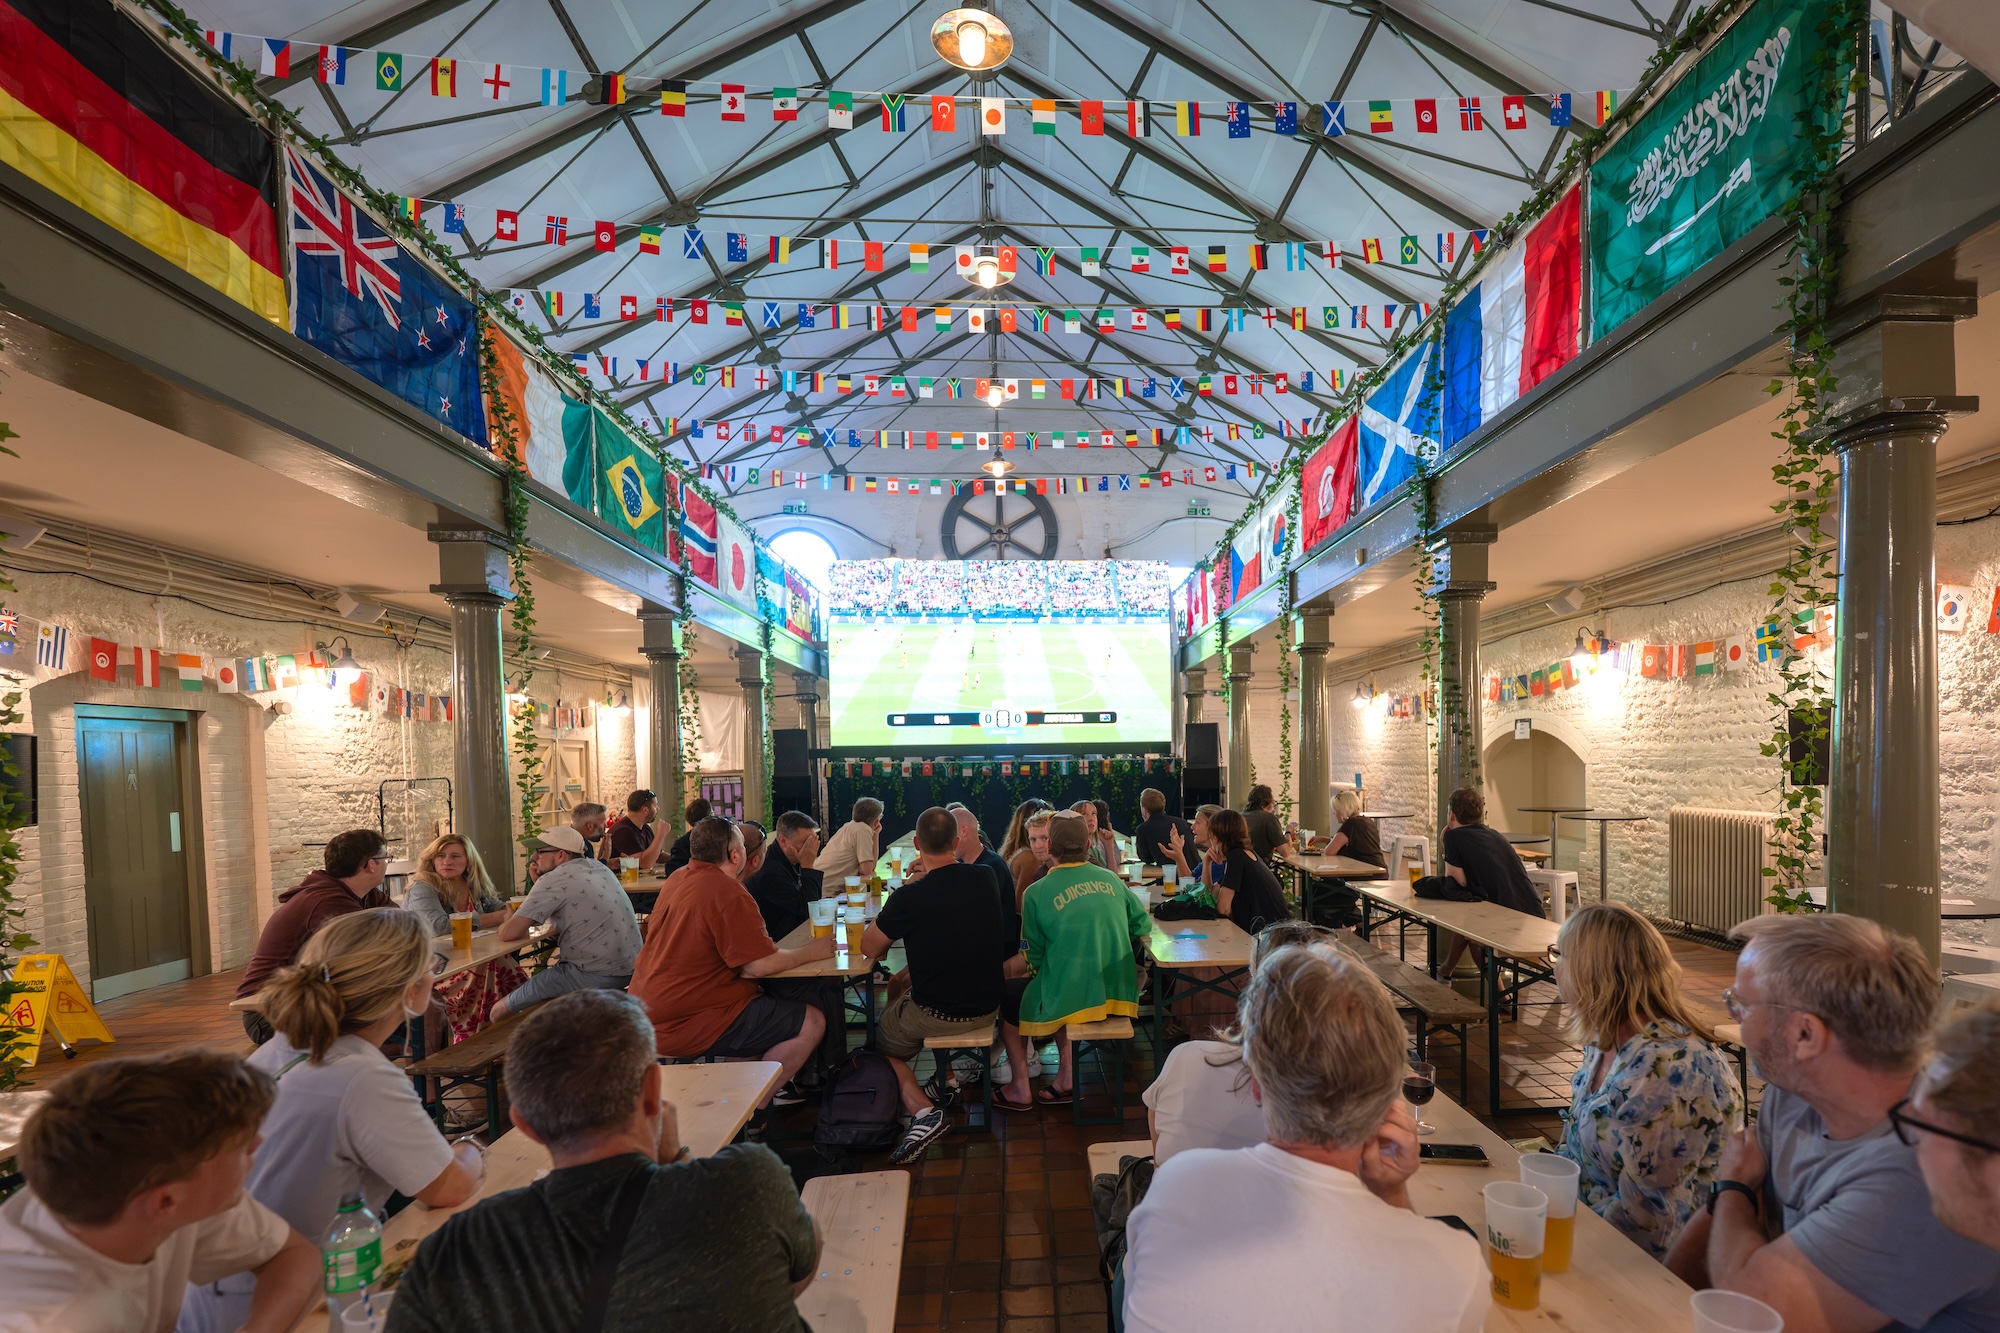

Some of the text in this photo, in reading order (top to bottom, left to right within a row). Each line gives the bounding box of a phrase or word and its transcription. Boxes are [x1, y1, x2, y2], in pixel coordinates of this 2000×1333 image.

[985, 714, 992, 724] 0
[1014, 714, 1021, 723] 0
[1053, 880, 1116, 911] QUIKSILVER
